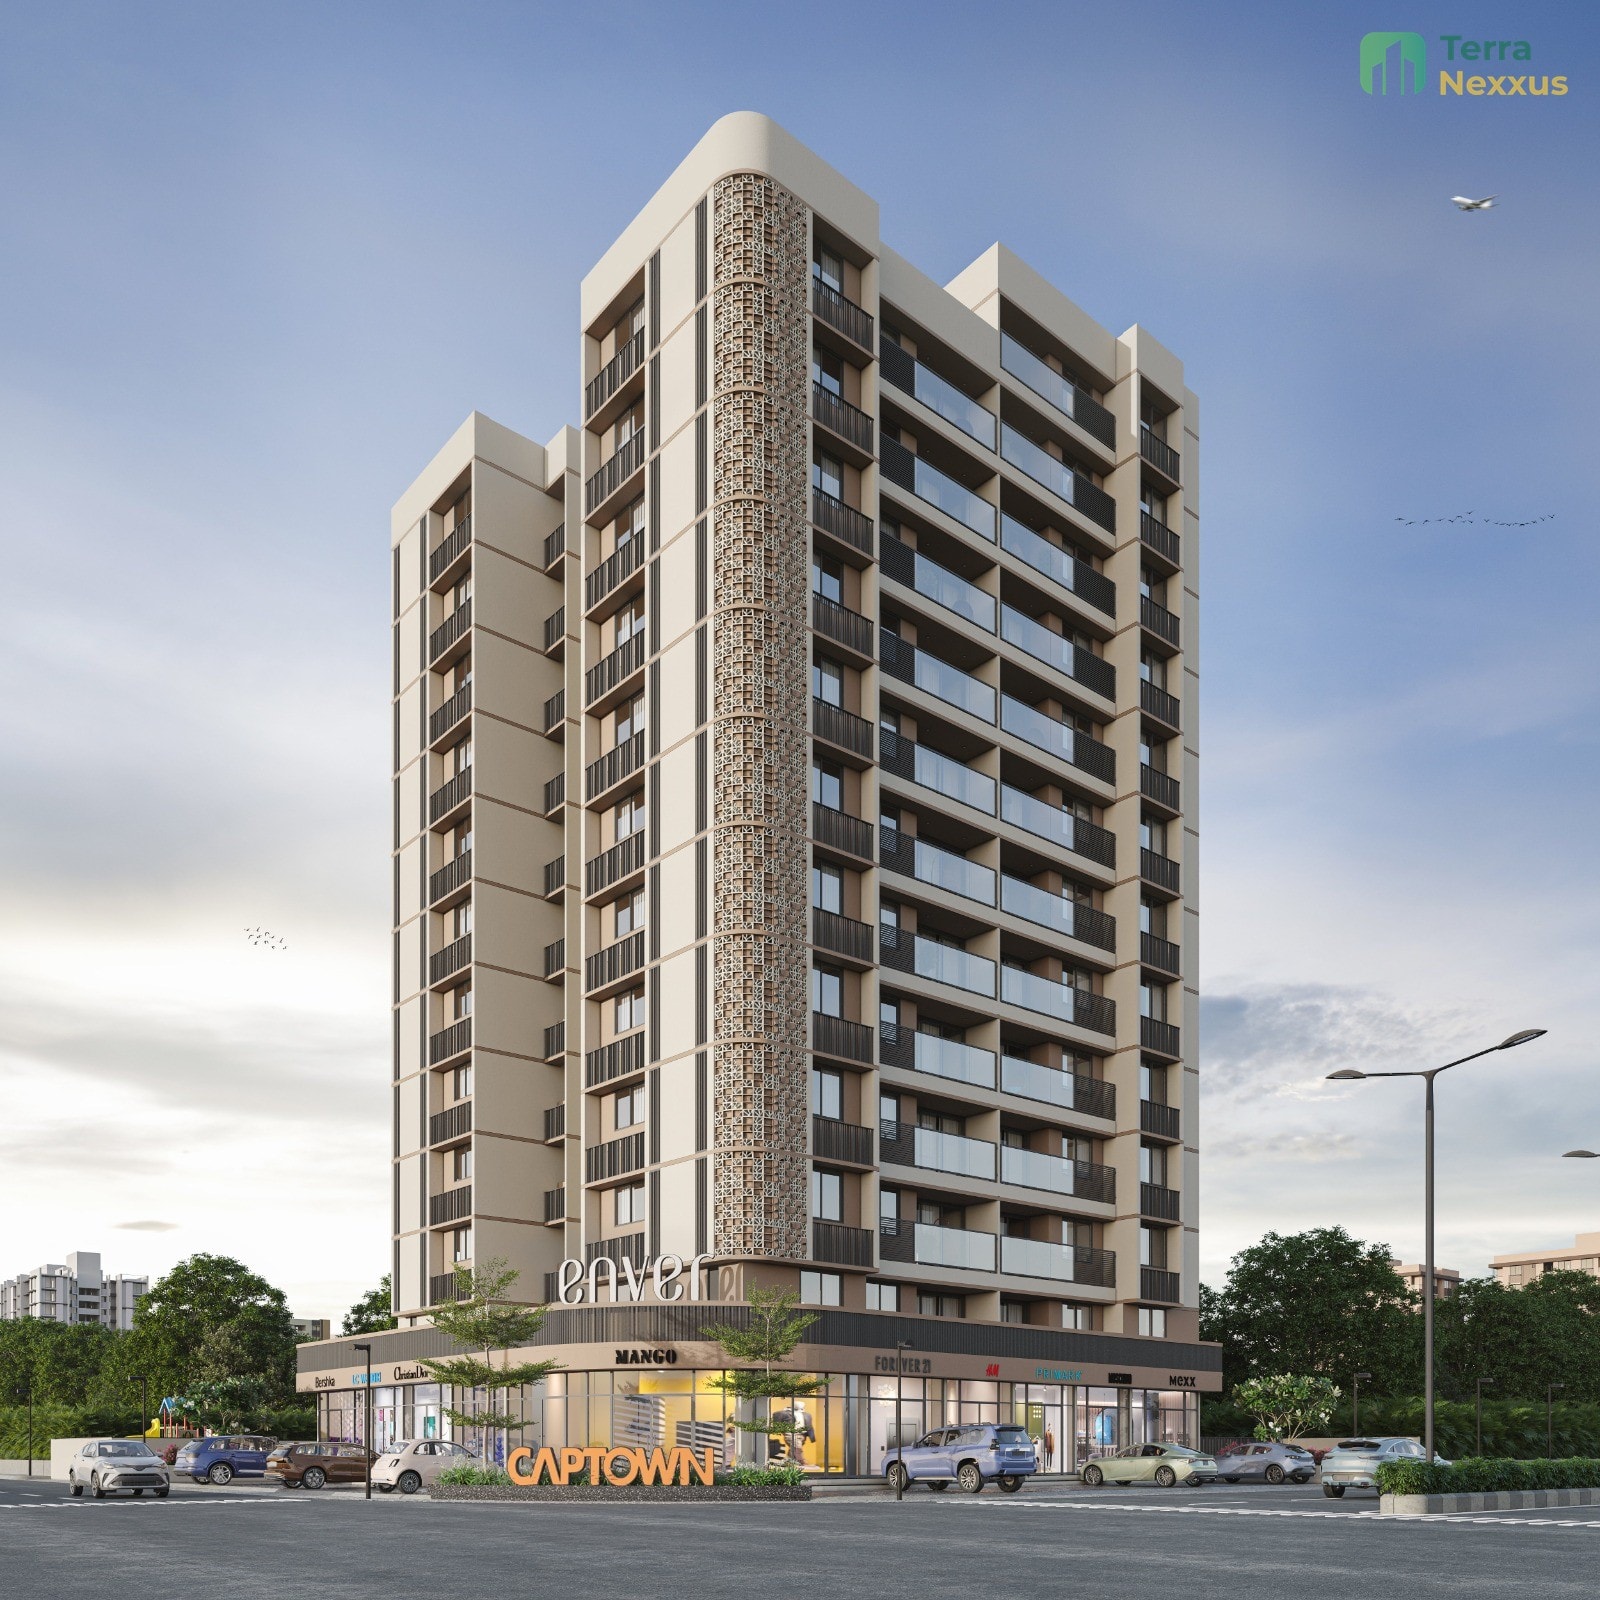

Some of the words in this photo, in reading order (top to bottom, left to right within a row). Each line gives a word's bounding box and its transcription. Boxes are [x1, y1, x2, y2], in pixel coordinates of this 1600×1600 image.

[615, 1349, 677, 1364] MANGO
[922, 1359, 931, 1374] 21
[315, 1376, 335, 1388] Bershka
[507, 1446, 714, 1486] CAPTOWN
